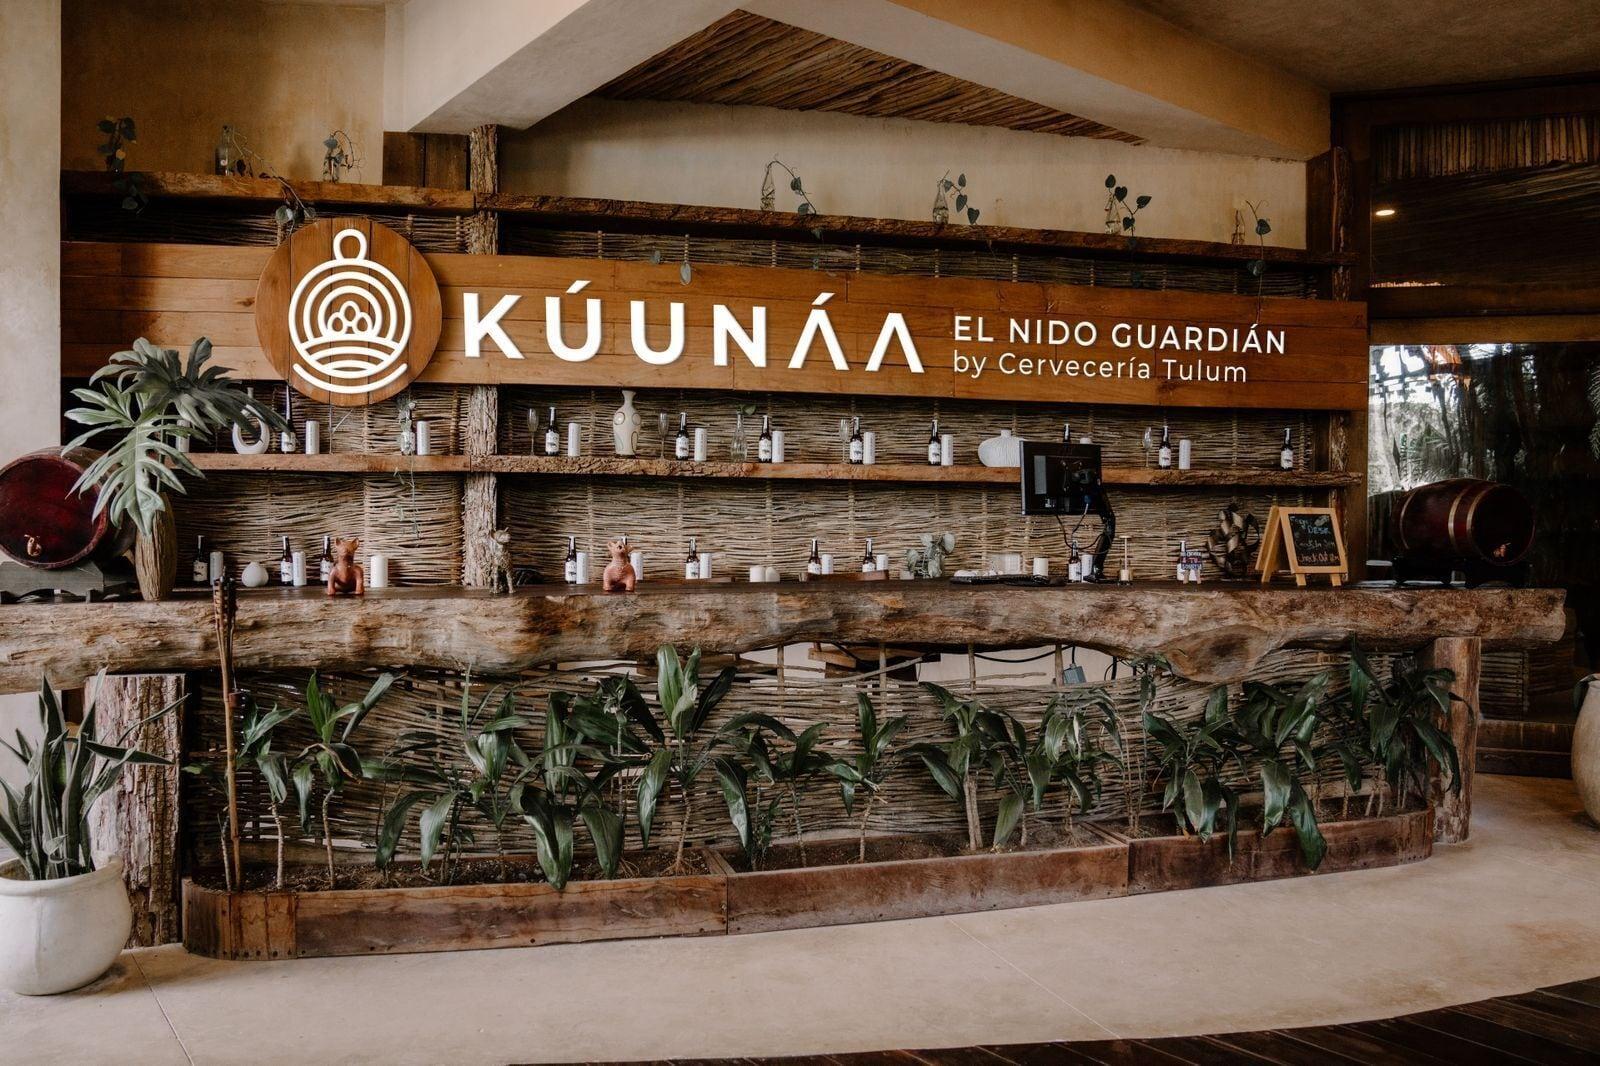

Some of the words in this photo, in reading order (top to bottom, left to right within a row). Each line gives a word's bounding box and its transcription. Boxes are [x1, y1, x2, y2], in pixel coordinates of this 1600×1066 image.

[463, 280, 925, 374] KÚUNÁA
[954, 315, 994, 342] EL
[1009, 318, 1098, 346] NIDO
[1111, 323, 1286, 354] GUARDIÁN
[954, 350, 987, 379] by
[999, 352, 1151, 380] Cervecería
[1162, 359, 1247, 383] Tulum
